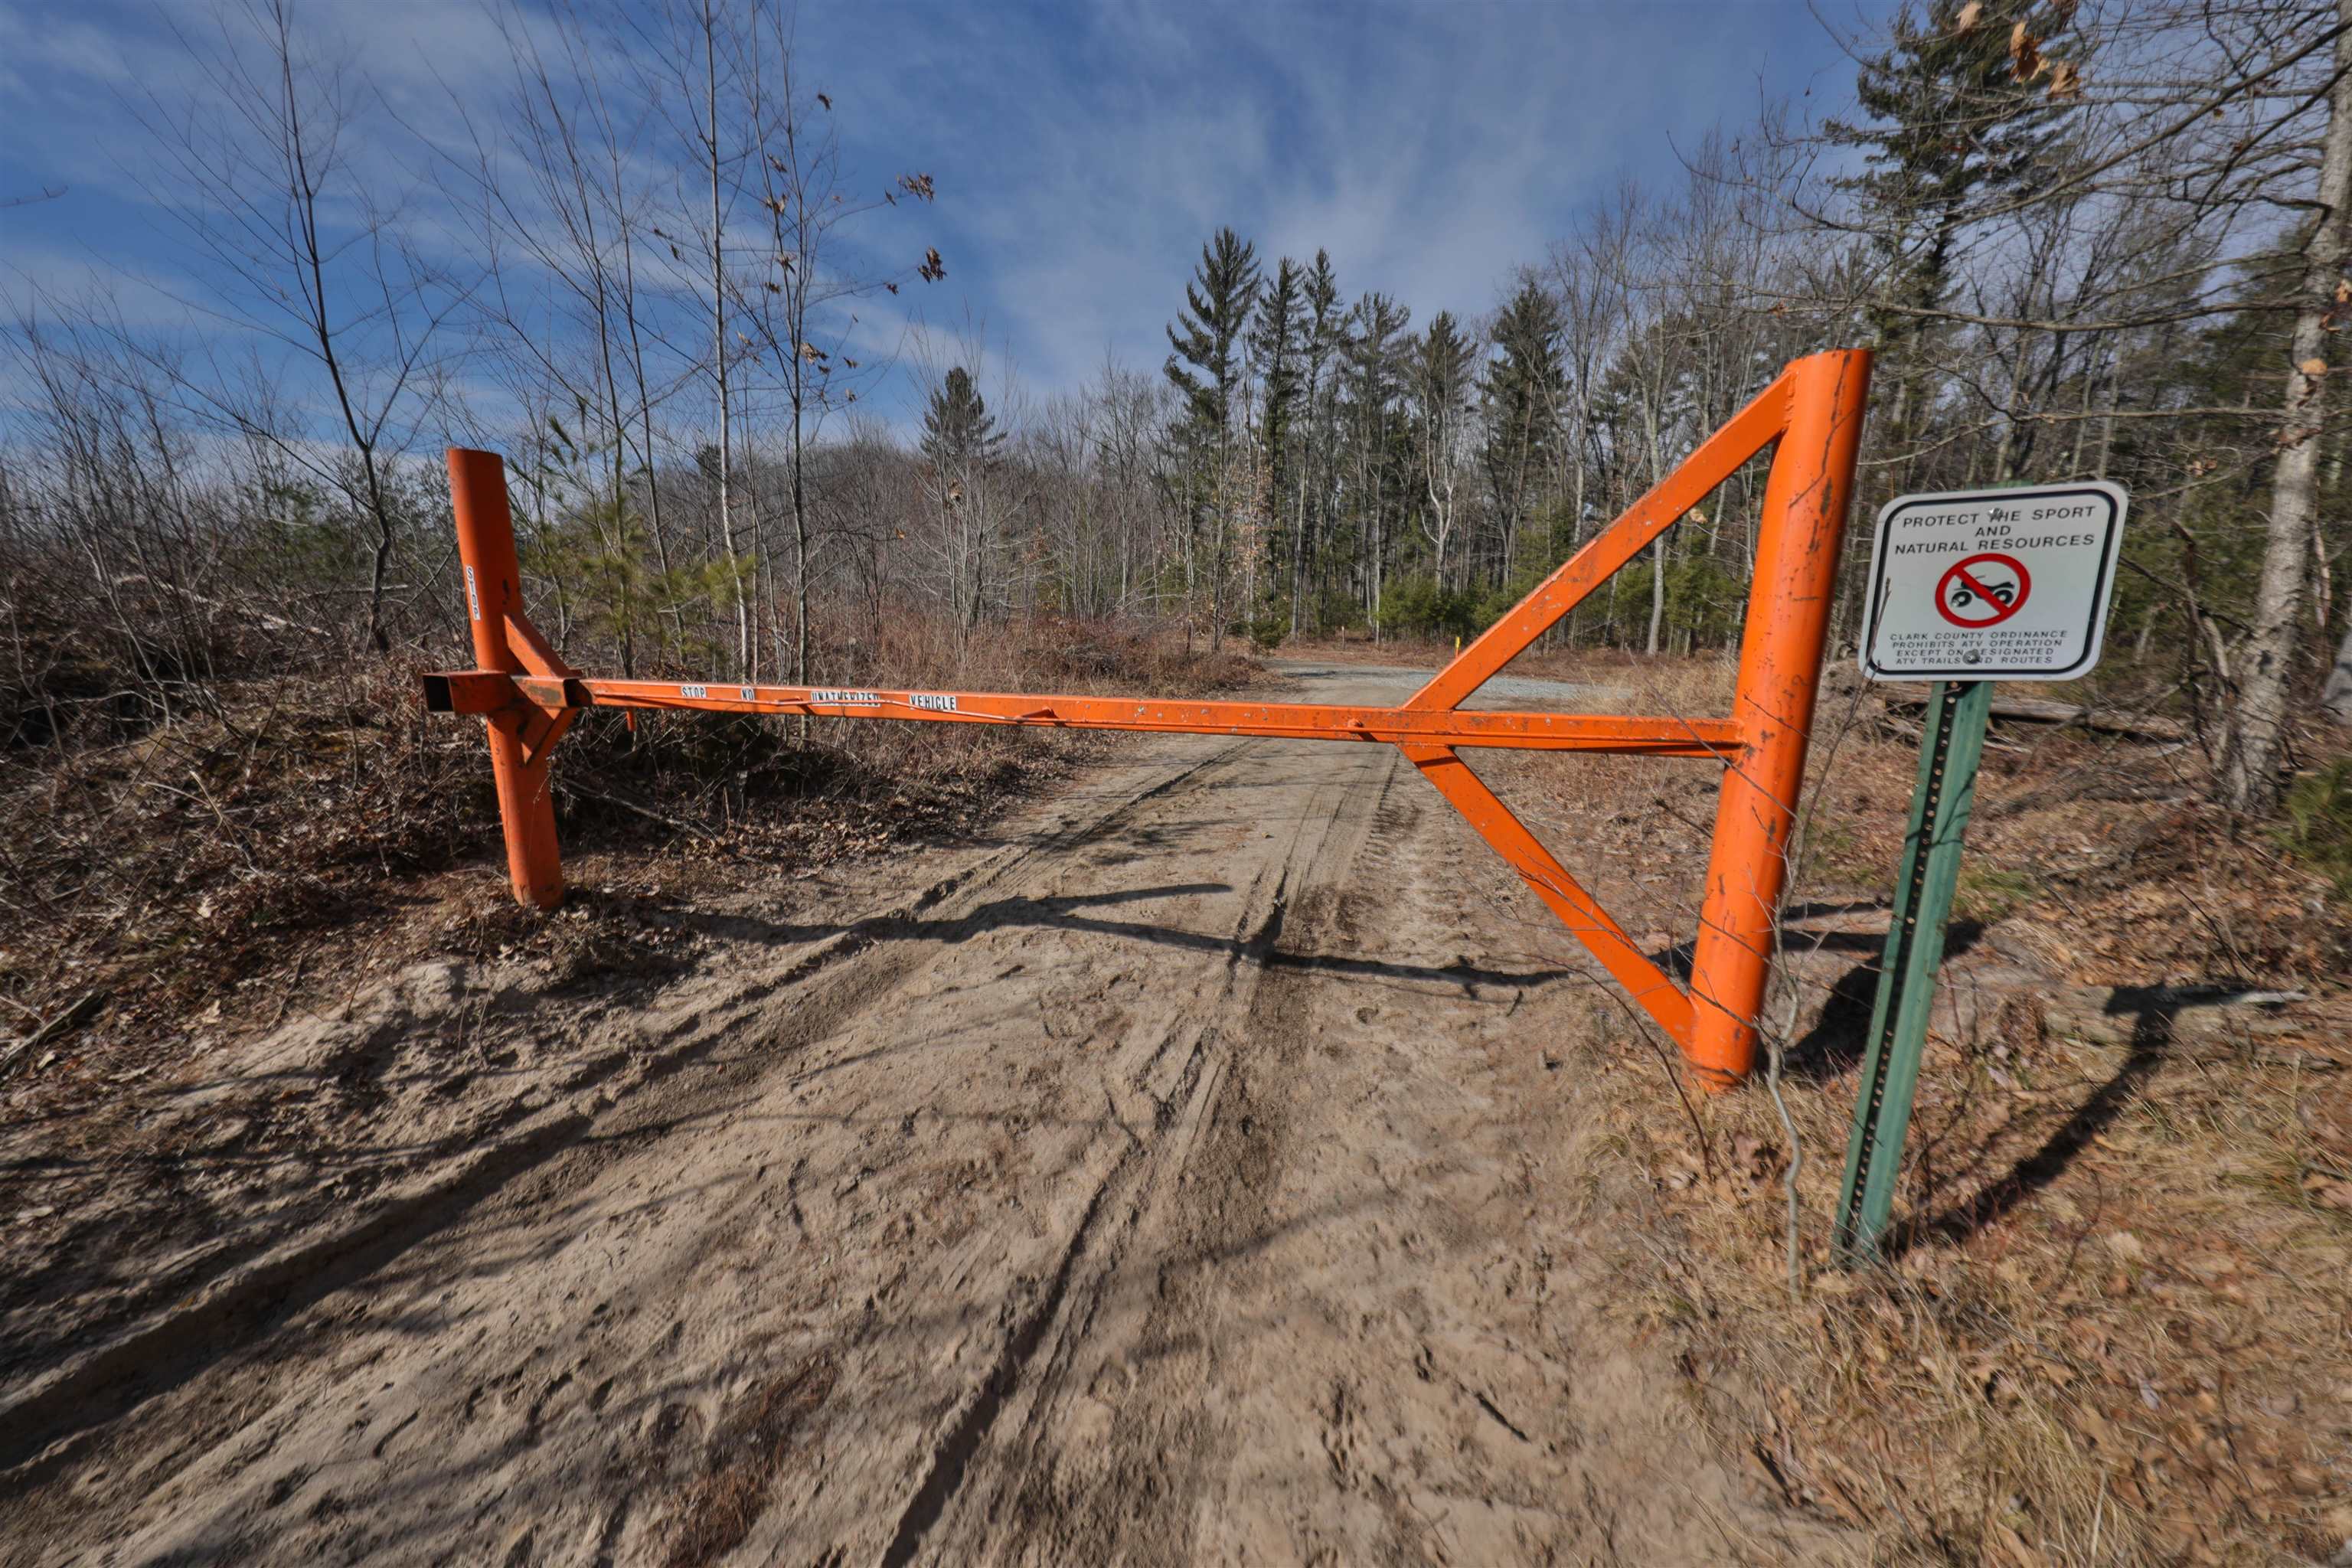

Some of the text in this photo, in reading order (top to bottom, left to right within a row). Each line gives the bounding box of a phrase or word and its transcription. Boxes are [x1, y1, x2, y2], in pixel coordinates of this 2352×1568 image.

[1903, 513, 1978, 528] PROTECT
[2031, 506, 2096, 521] SPORT
[1975, 525, 2011, 537] AND
[1894, 534, 2094, 555] NATURAL RESOURCES
[466, 566, 479, 619] STOP
[1890, 630, 2067, 641] CLARK COUNTY ORDINANCE
[1990, 639, 2063, 647] OPERATION
[1896, 648, 1941, 657] EXCEPT
[1973, 648, 2053, 656] ESIGNATED
[682, 687, 706, 698] STOP
[741, 688, 754, 701] NO
[910, 695, 956, 710] VEHICLE
